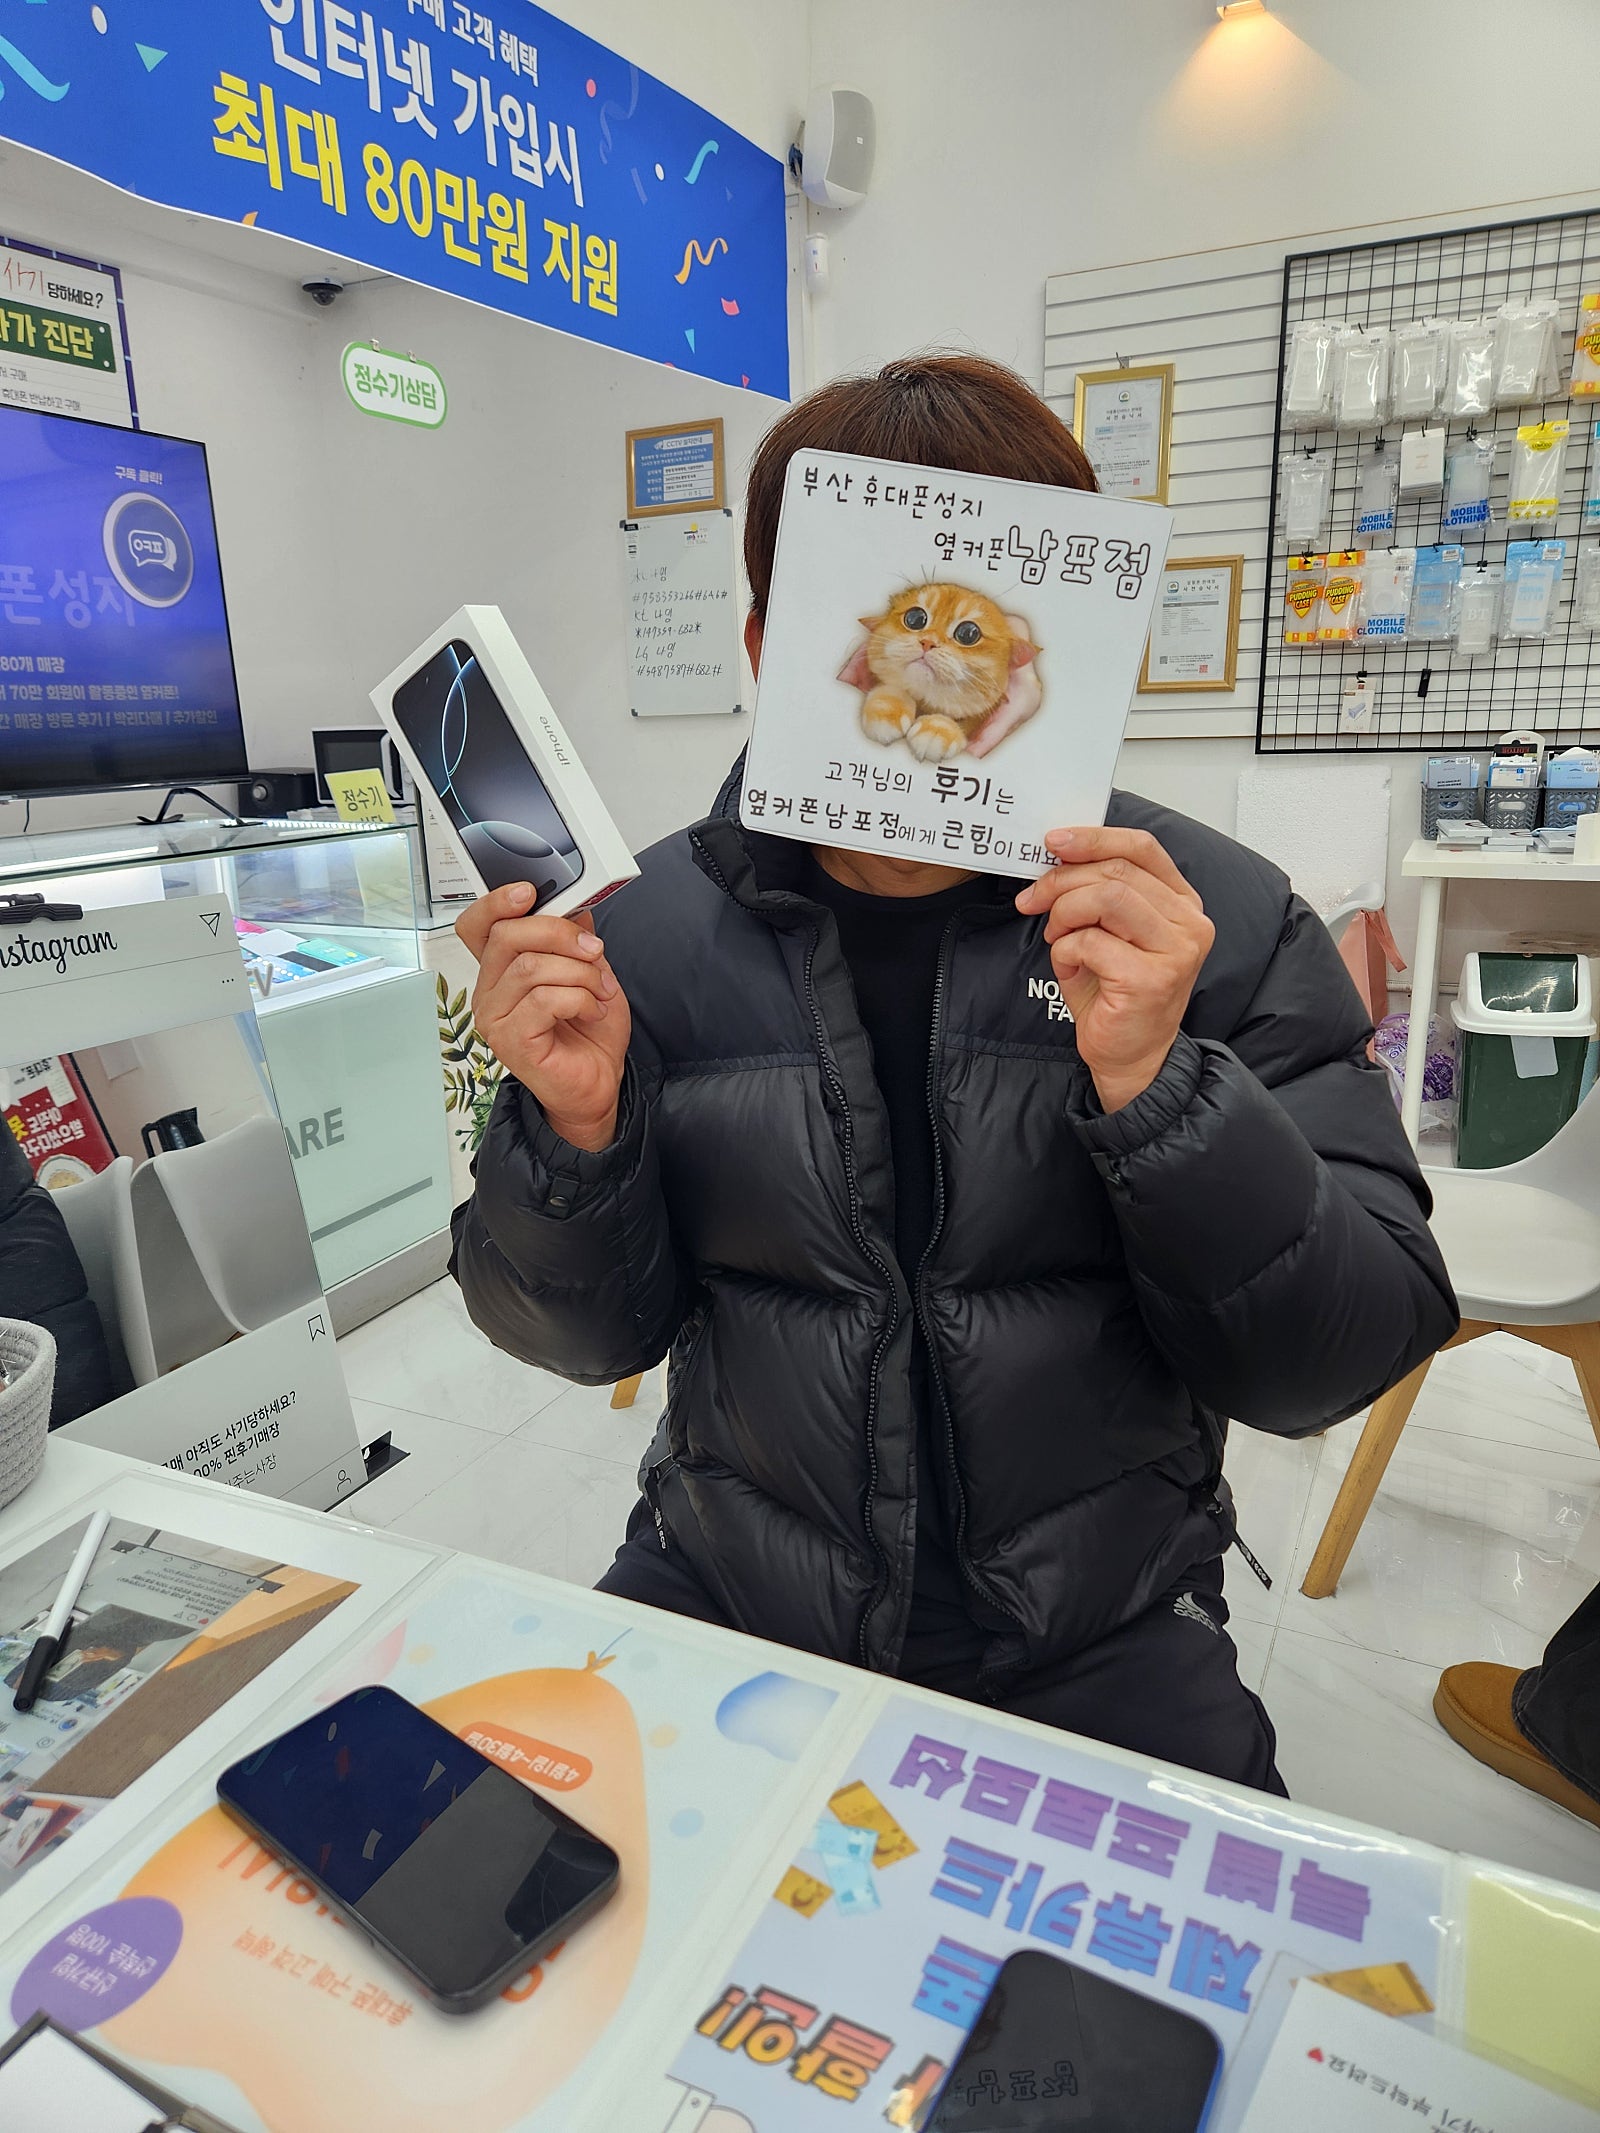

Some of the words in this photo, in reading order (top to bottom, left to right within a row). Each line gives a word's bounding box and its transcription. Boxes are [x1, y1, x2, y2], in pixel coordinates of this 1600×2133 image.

[453, 3, 496, 60] 고객
[499, 29, 539, 87] 혜택
[259, 0, 438, 140] 인터넷
[451, 69, 584, 208] 가입시
[212, 71, 347, 216] 최대
[363, 142, 529, 285] 80만원
[542, 218, 618, 317] 지원
[4, 257, 44, 296] 사기
[48, 282, 104, 309] 당하세요?
[41, 318, 94, 360] 진단
[354, 362, 437, 411] 정수기상담
[803, 466, 853, 503] 부산
[862, 476, 984, 520] 휴대폰성지
[1361, 512, 1394, 524] MOBILE
[1289, 590, 1317, 603] PUDDING
[1295, 599, 1310, 610] CASE
[1325, 585, 1355, 598] PUDDING
[1330, 594, 1347, 606] CASE
[1357, 626, 1405, 635] CLOTHING
[1367, 618, 1406, 627] MOBILE
[37, 657, 65, 673] 매장
[9, 685, 43, 701] 70만
[46, 685, 85, 701] 회원이
[539, 715, 571, 766] iPhone
[342, 786, 384, 811] 정수기
[824, 761, 913, 794] 고객님의
[931, 766, 1015, 815] 후기는
[1028, 977, 1064, 1001] NO
[186, 1433, 224, 1463] 아직도
[225, 1391, 297, 1441] 사기당하세요?
[224, 1421, 280, 1466] 찐후기매장
[888, 1733, 1191, 1880] 프로모션
[1203, 1830, 1373, 1943] 특별
[928, 1835, 1264, 2014] 제휴카드
[695, 1982, 896, 2104] 할인!
[1328, 2054, 1432, 2116] 부탁드려요
